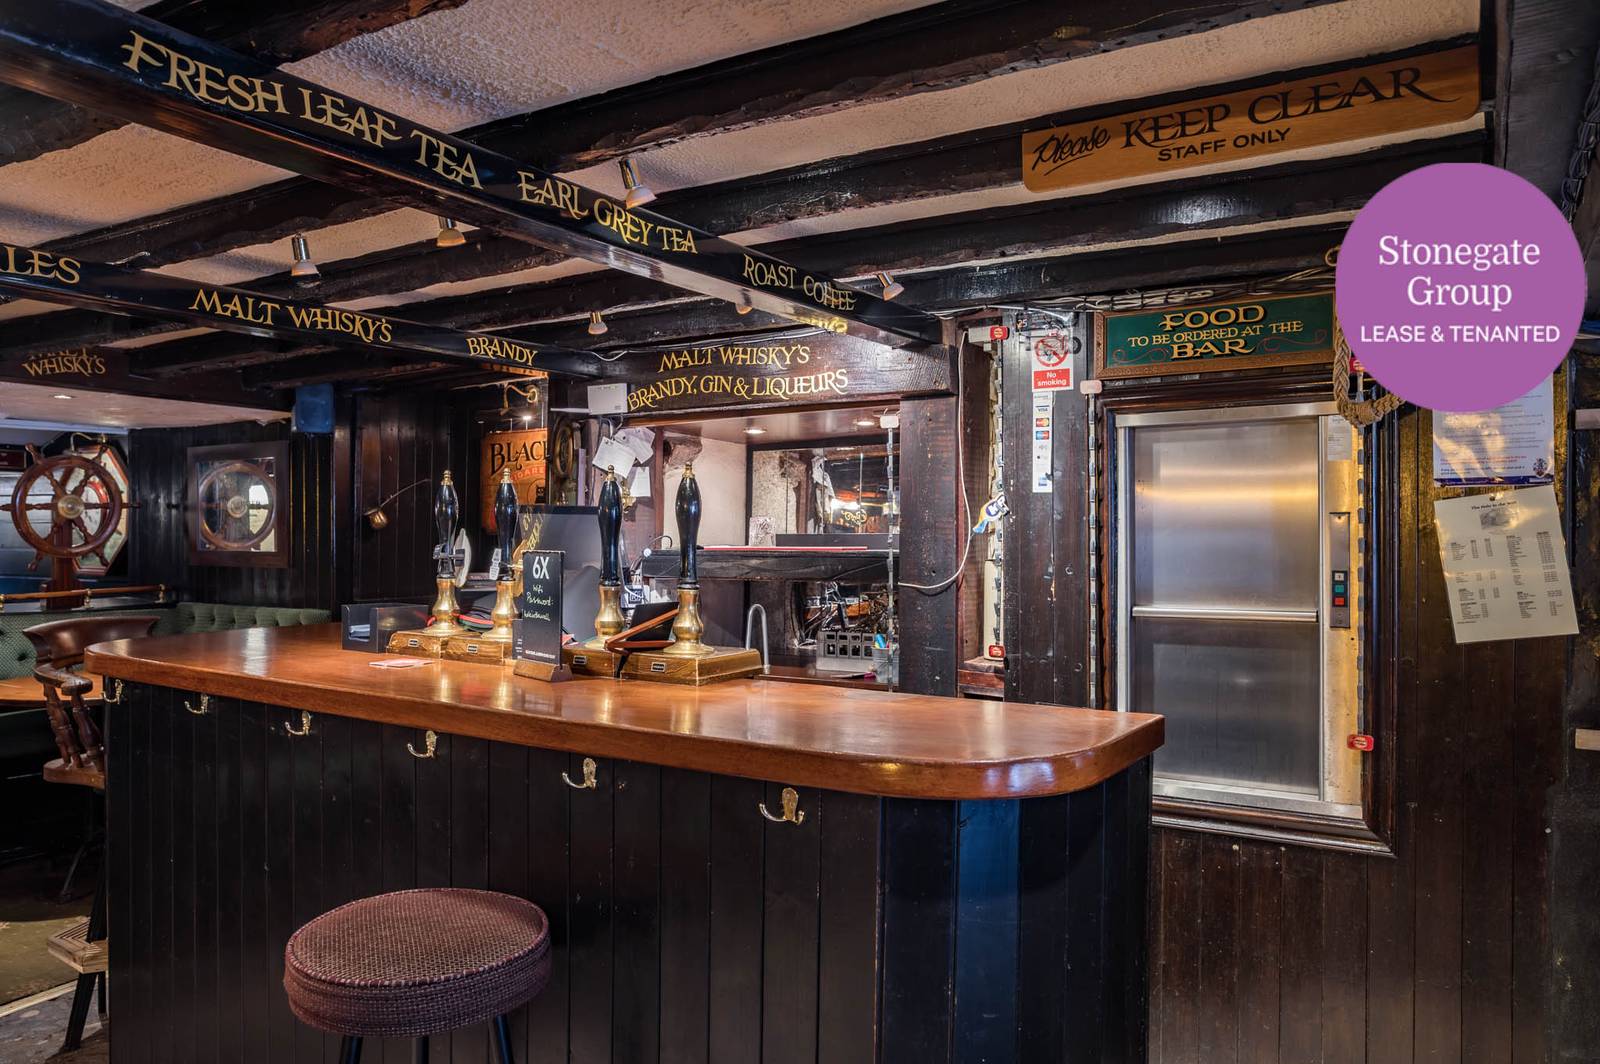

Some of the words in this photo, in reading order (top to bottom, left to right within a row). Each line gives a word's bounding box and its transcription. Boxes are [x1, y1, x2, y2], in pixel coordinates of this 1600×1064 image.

[121, 30, 290, 114] FRESH
[298, 87, 402, 148] LEAF
[410, 129, 483, 190] TEA
[1031, 125, 1111, 172] Please
[1120, 103, 1231, 149] KEEP
[1247, 67, 1463, 125] CLEAR
[1158, 138, 1226, 161] STAFF
[1233, 127, 1291, 148] ONLY
[517, 171, 589, 220] EARL
[594, 198, 653, 246] GREY
[656, 226, 698, 254] TEA
[0, 245, 81, 284] LES
[742, 253, 797, 289] ROAST
[803, 275, 857, 310] COFFEE
[188, 289, 280, 326] MALT
[286, 305, 392, 343] WHISKY'S
[1158, 304, 1267, 331] FOOD
[1128, 335, 1149, 347] TO
[1152, 333, 1171, 344] BE
[1173, 327, 1239, 343] ORDERED
[1241, 325, 1264, 337] AT
[1269, 320, 1304, 334] THE
[1170, 338, 1257, 360] BAR
[22, 355, 106, 376] WHISKY'S
[466, 337, 538, 366] BRANDY
[657, 346, 718, 373] MALT
[720, 344, 811, 369] WHISKY'S
[627, 376, 698, 411] BRANDY,
[700, 375, 733, 394] GIN
[733, 377, 752, 399] &
[752, 368, 849, 400] LIQUEURS
[1037, 378, 1067, 387] smoking
[532, 556, 550, 579] 6X
